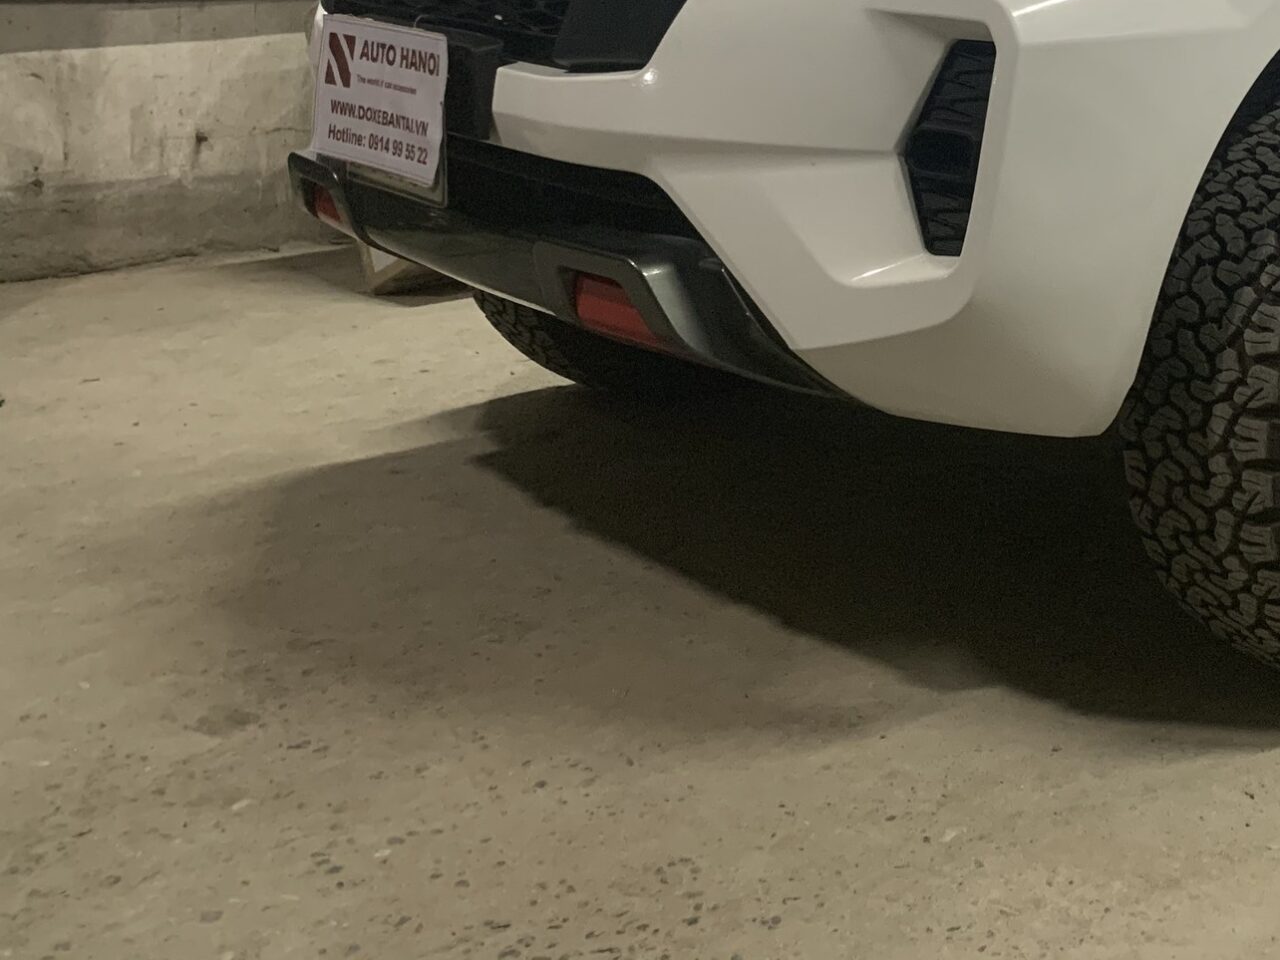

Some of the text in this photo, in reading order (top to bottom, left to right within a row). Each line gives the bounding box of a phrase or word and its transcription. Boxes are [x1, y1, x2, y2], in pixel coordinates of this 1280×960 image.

[359, 40, 440, 77] AUTO HANOI
[330, 99, 429, 137] WWW.DOXEBANTAI.VN
[328, 124, 428, 166] Hotline: 0914 99 55 22
